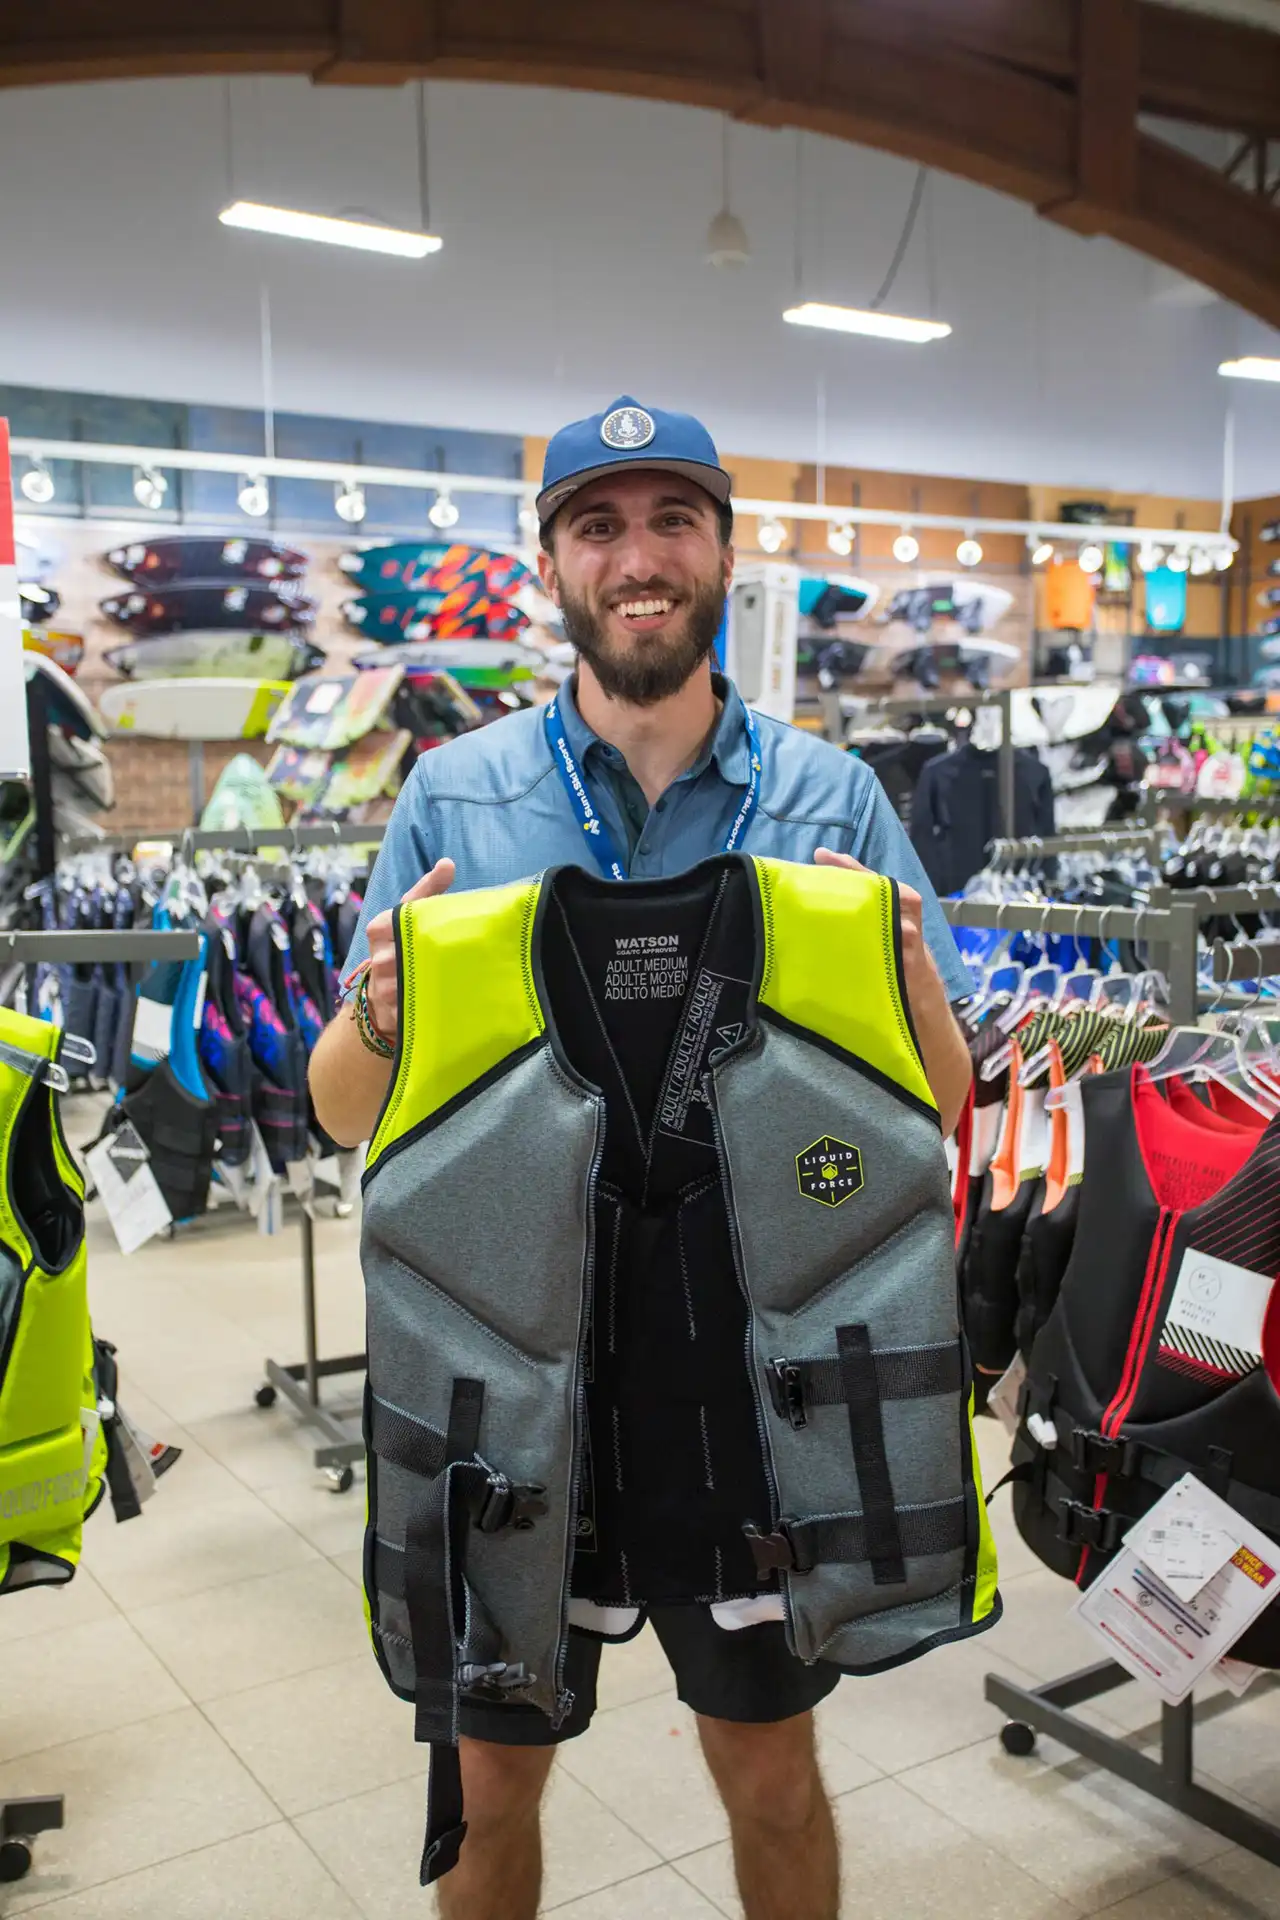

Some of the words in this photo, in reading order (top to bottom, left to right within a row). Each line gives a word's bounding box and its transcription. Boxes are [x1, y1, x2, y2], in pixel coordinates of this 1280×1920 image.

[557, 737, 575, 774] Sports
[726, 813, 745, 851] Sports
[615, 935, 679, 949] WATSON
[606, 960, 641, 973] ADULT
[644, 956, 688, 971] MEDIUM
[605, 973, 646, 986] ADULTE
[650, 969, 688, 985] MOYEN
[605, 987, 648, 1000] ADULTO
[651, 983, 685, 998] MEDIO
[660, 1084, 680, 1126] ADULT
[672, 1030, 695, 1080] ADULTE
[688, 974, 711, 1025] ADULTO
[692, 1089, 702, 1102] 70
[804, 1152, 852, 1165] LIQUID
[811, 1178, 852, 1190] FORCE
